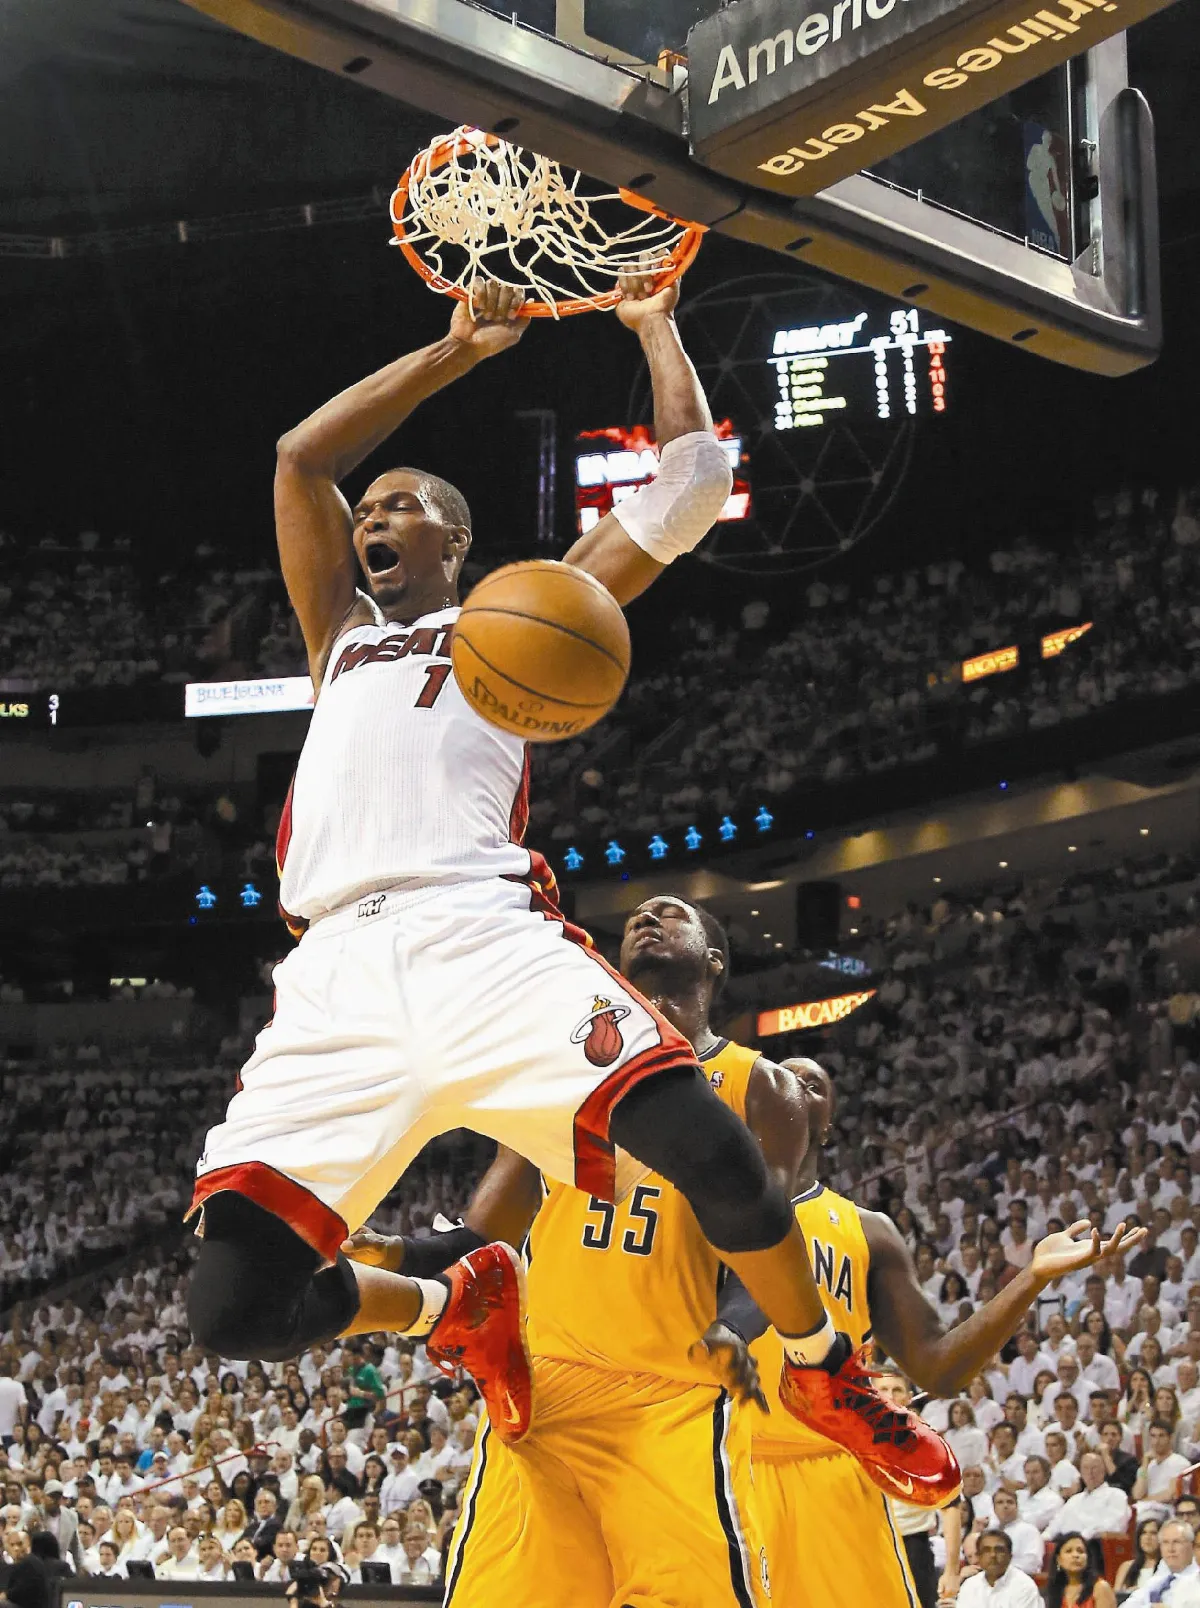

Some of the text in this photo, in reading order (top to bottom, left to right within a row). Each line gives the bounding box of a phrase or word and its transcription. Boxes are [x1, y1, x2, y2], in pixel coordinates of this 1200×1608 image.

[757, 88, 927, 175] Arena
[890, 308, 919, 335] 51
[413, 663, 452, 709] 1
[580, 1183, 662, 1256] 55
[811, 1236, 853, 1314] NA
